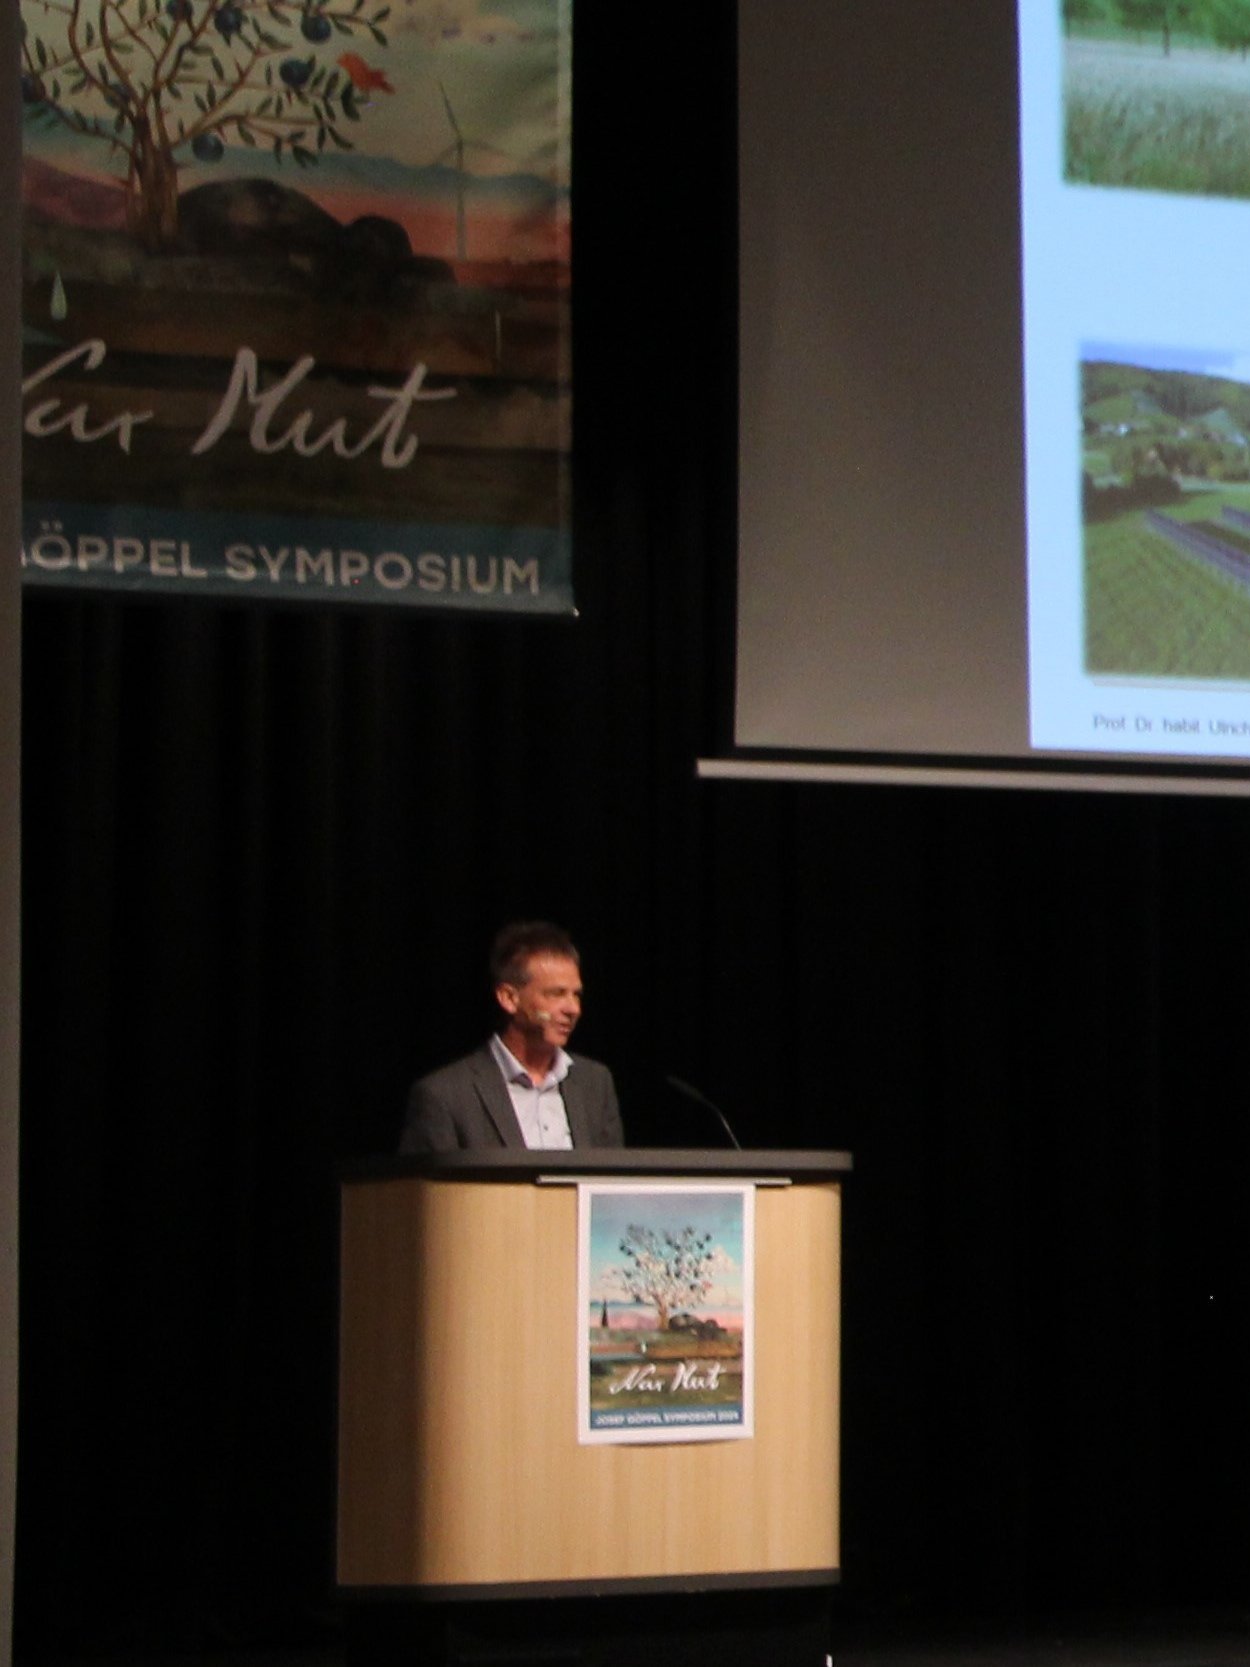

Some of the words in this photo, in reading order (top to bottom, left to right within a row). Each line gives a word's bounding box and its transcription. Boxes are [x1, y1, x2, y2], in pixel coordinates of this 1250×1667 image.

[191, 346, 457, 469] Mut
[22, 520, 208, 579] ÖPPEL
[224, 543, 540, 596] SYMPOSIUM
